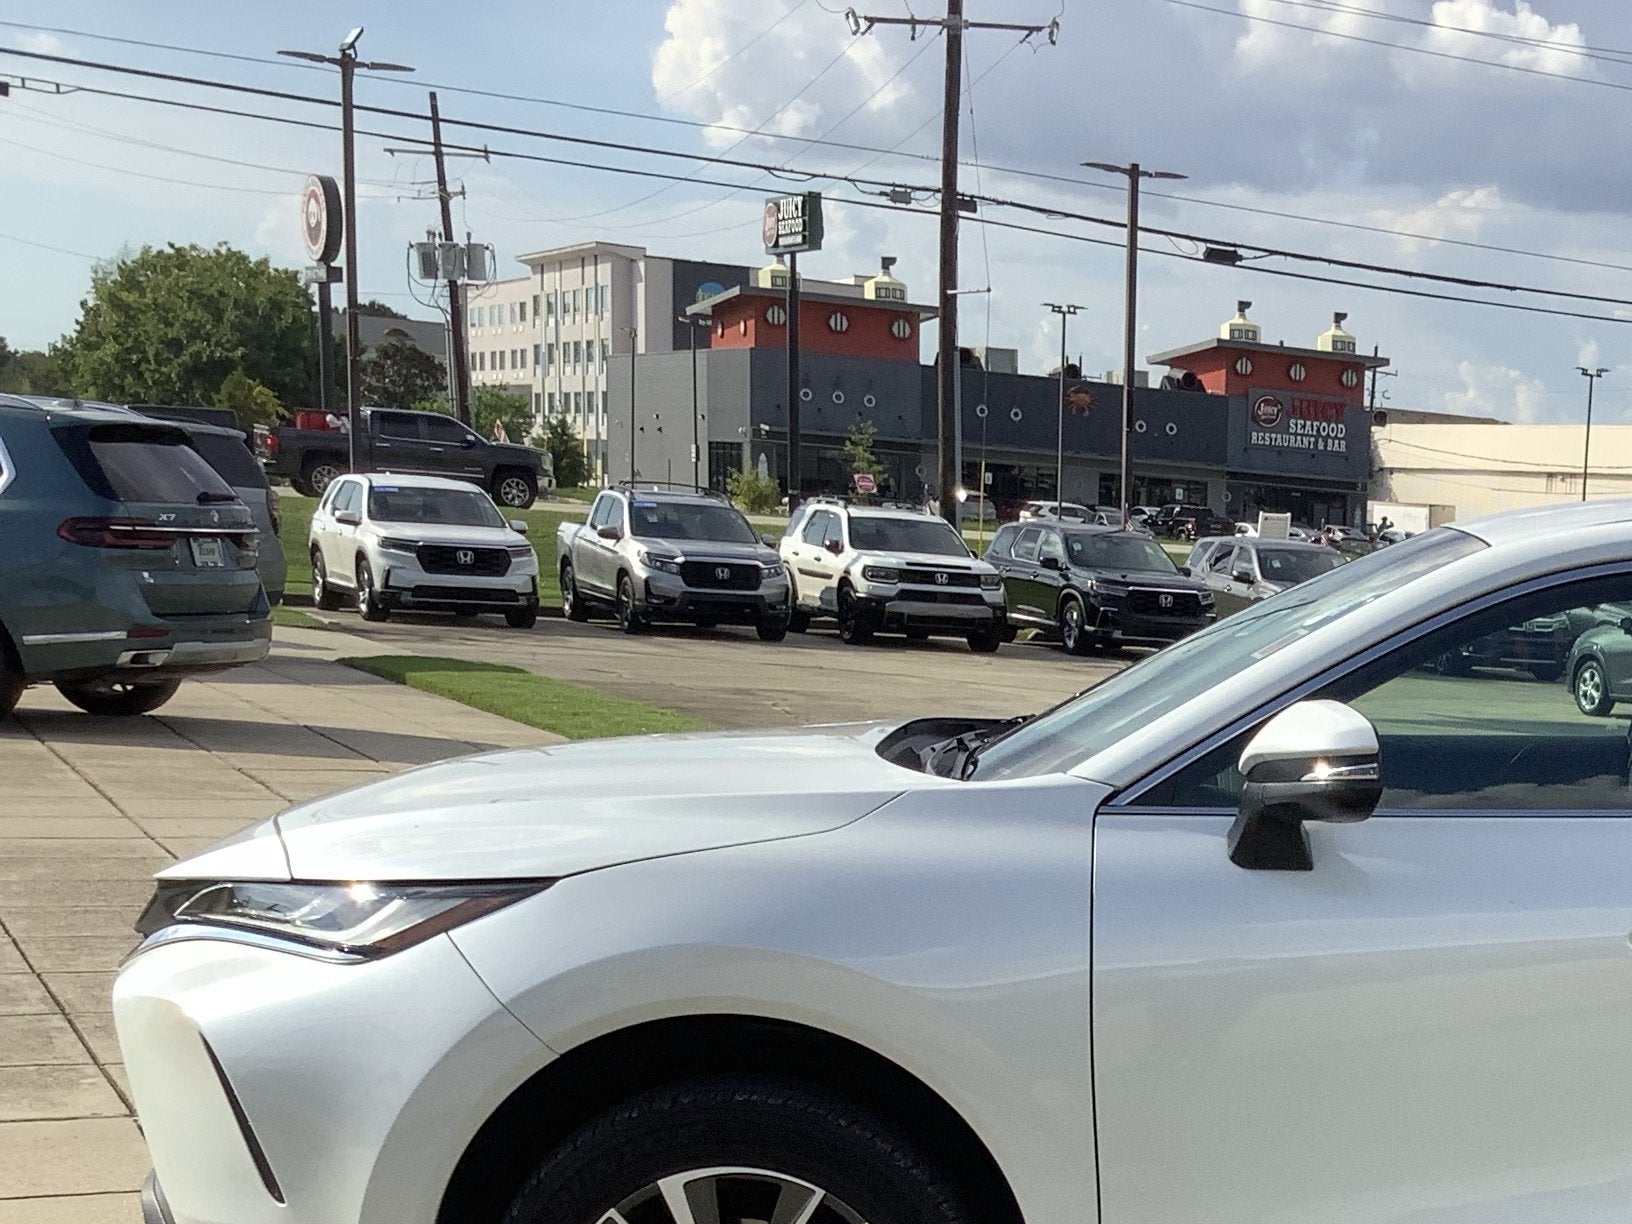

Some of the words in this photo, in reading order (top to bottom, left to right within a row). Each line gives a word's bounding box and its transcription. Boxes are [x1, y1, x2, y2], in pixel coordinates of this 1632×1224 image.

[778, 195, 804, 220] JUICY
[1289, 418, 1346, 438] SEAFOOD
[1250, 431, 1316, 449] RESTAURANT
[1317, 437, 1325, 451] &
[1326, 439, 1347, 453] BAR
[159, 513, 176, 521] X7
